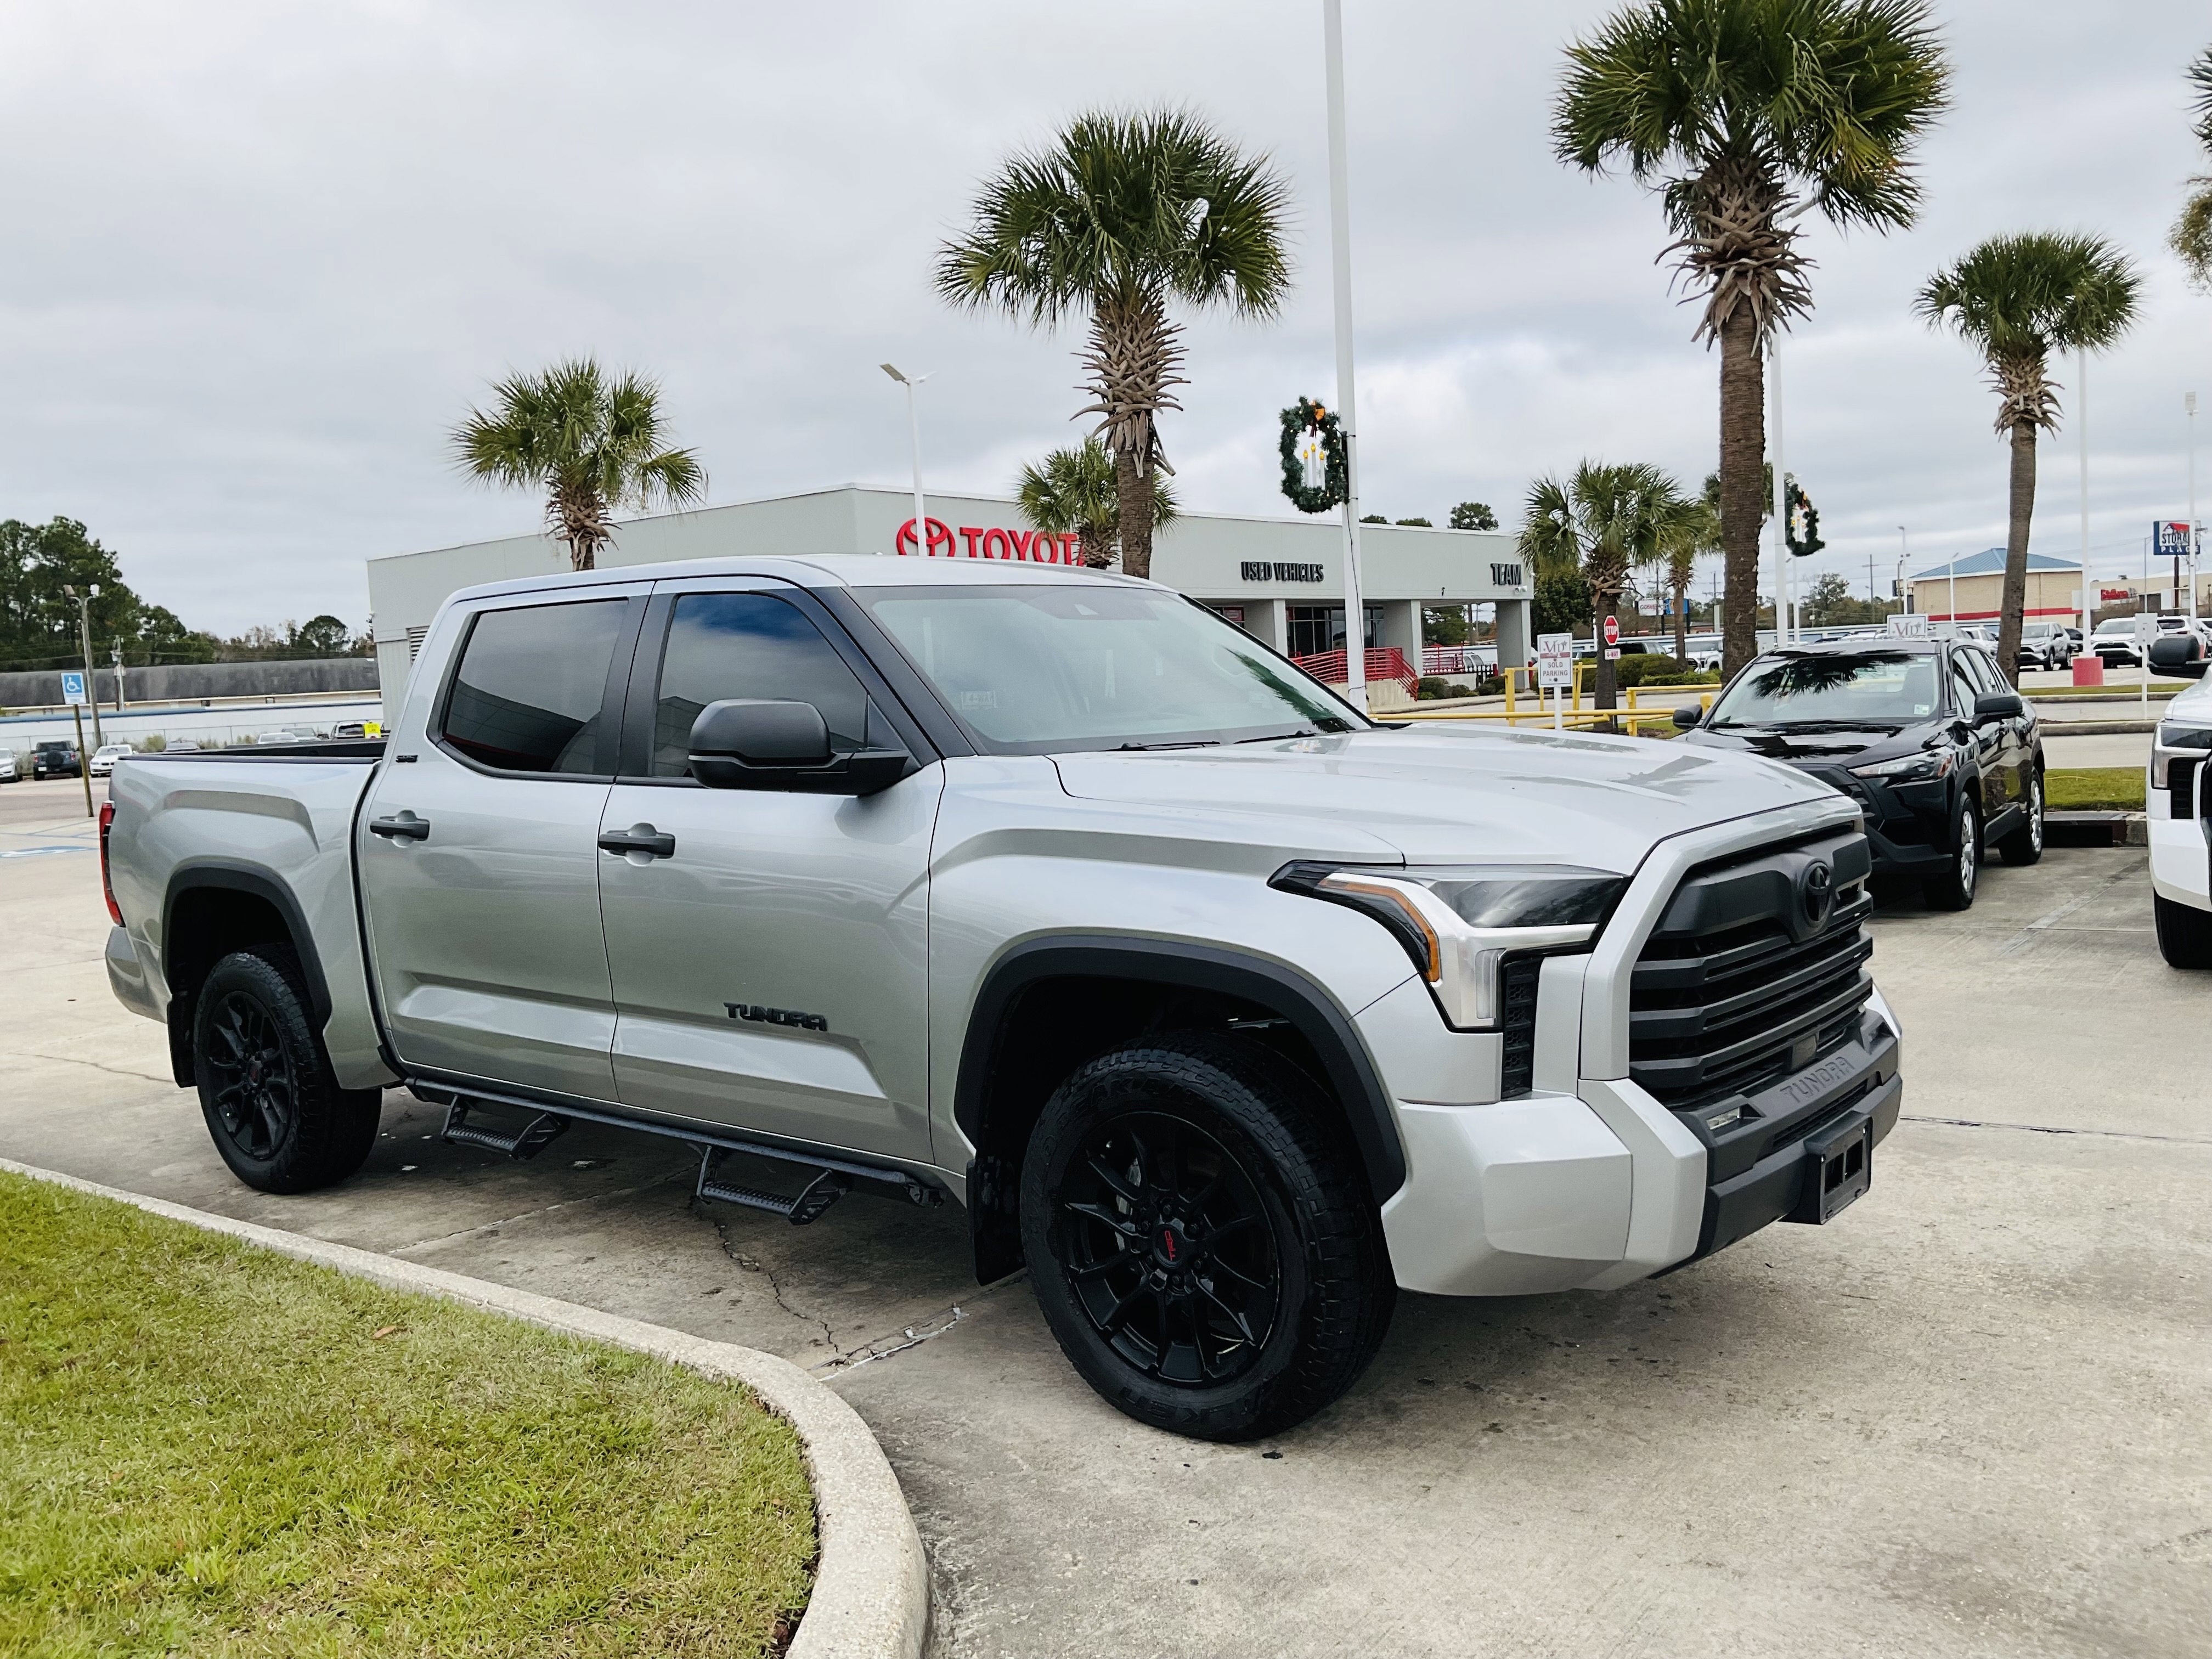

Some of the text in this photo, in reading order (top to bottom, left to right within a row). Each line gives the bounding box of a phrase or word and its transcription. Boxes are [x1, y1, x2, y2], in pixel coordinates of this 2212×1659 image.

[2162, 533, 2198, 544] STORA
[1241, 561, 1324, 582] USED VEHICLES
[1491, 563, 1521, 585] TEAM
[1605, 625, 1617, 635] STOP
[723, 1002, 827, 1031] TUNDRA
[1780, 1056, 1855, 1103] TUNDRA
[1165, 1231, 1176, 1261] TRD
